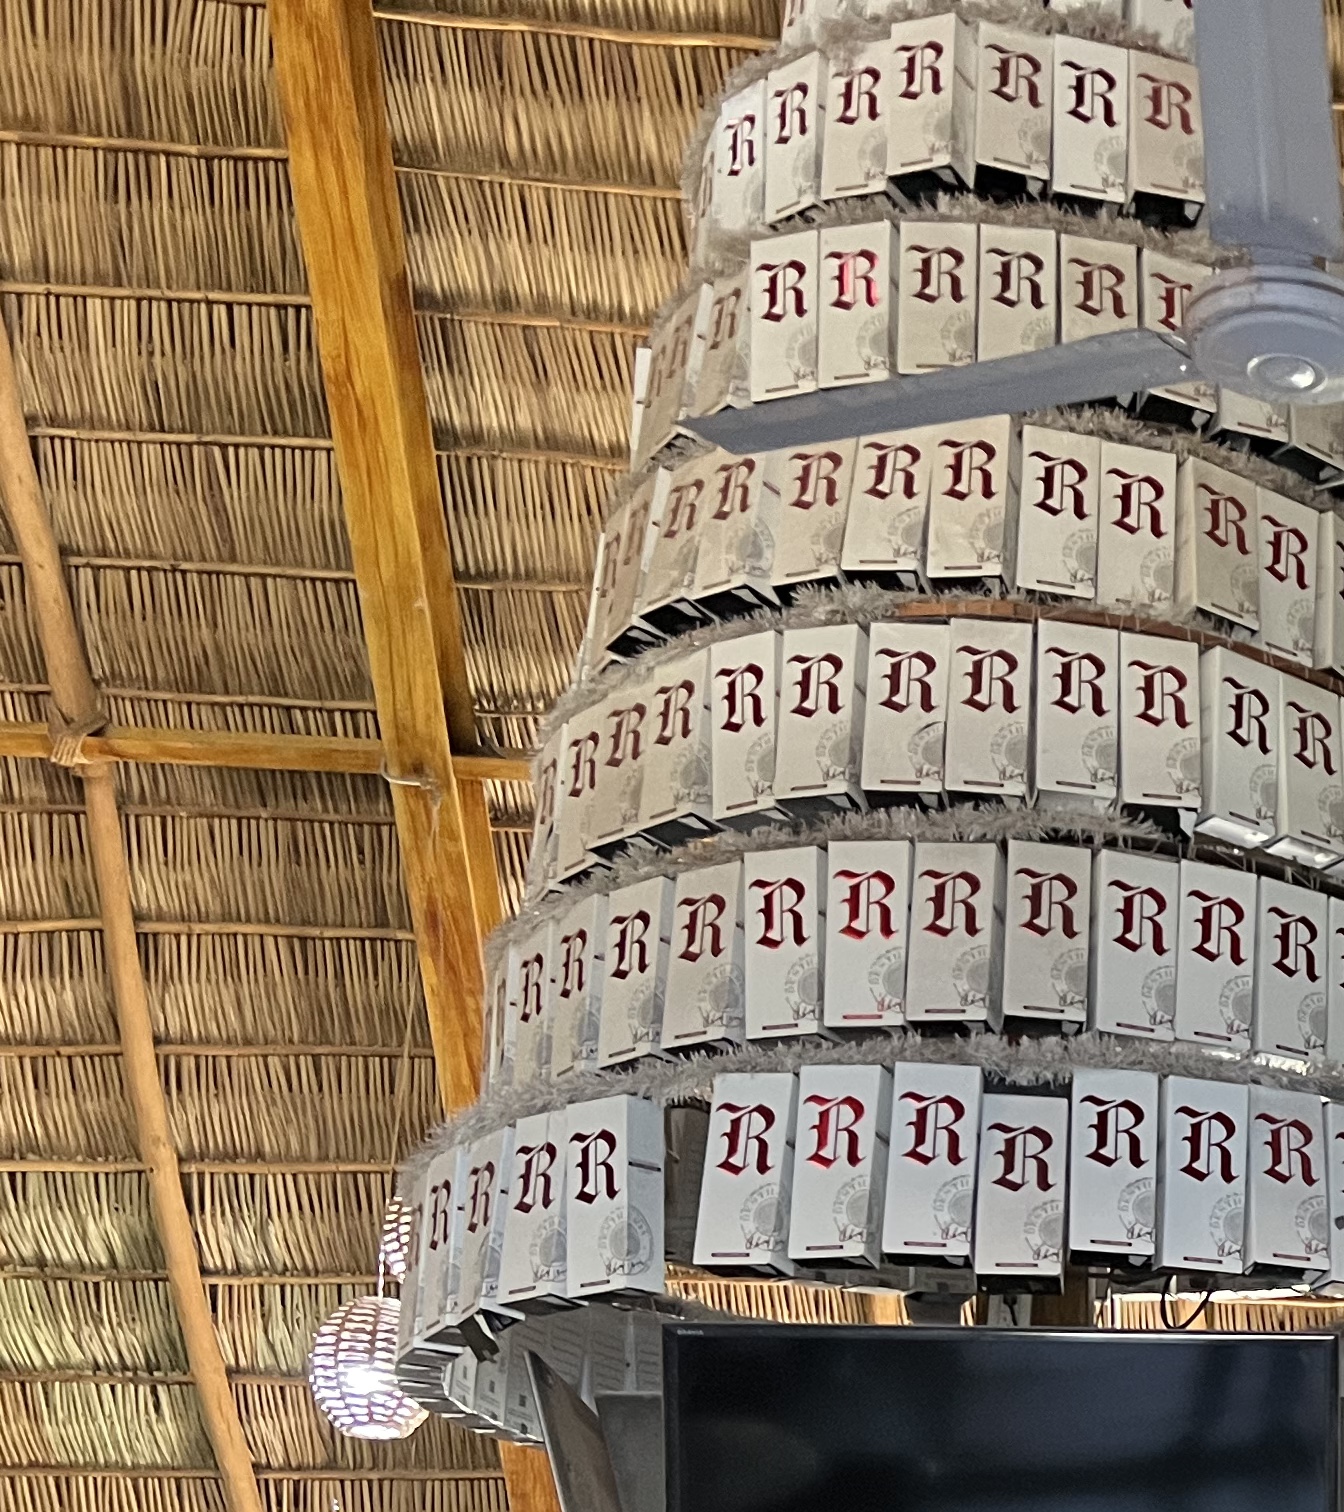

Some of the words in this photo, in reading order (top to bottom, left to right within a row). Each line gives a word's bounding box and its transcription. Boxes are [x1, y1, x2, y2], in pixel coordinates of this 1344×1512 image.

[832, 66, 881, 125] R
[894, 41, 943, 99] R
[985, 43, 1044, 108] R
[1061, 60, 1117, 127] R
[1137, 72, 1194, 134] R
[723, 113, 756, 176] R
[774, 82, 808, 145] R
[756, 259, 806, 322] R
[825, 249, 880, 310] R
[906, 244, 965, 305] R
[986, 248, 1048, 310] R
[1075, 257, 1130, 319] R
[709, 287, 741, 350] R
[712, 458, 755, 520] R
[790, 451, 842, 510] R
[861, 443, 921, 499] R
[937, 439, 998, 500] R
[1030, 450, 1088, 519] R
[1107, 467, 1166, 539] R
[664, 479, 704, 538] R
[1199, 483, 1250, 555] R
[1262, 514, 1310, 590] R
[655, 679, 695, 745] R
[715, 662, 766, 732] R
[789, 652, 844, 720] R
[877, 647, 939, 715] R
[958, 646, 1021, 715] R
[1046, 646, 1109, 718] R
[1128, 659, 1190, 731] R
[1225, 676, 1271, 755] R
[569, 731, 599, 797] R
[605, 703, 647, 767] R
[1286, 701, 1337, 775] R
[679, 892, 726, 966] R
[749, 876, 808, 953] R
[832, 867, 898, 942] R
[918, 869, 983, 940] R
[1013, 867, 1078, 940] R
[1110, 878, 1169, 956] R
[1186, 889, 1246, 966] R
[560, 928, 587, 998] R
[610, 909, 650, 979] R
[1266, 904, 1320, 982] R
[521, 952, 543, 1023] R
[716, 1101, 776, 1178] R
[803, 1092, 868, 1171] R
[900, 1090, 966, 1167] R
[988, 1122, 1054, 1193] R
[1079, 1095, 1149, 1168] R
[1174, 1105, 1240, 1185] R
[1254, 1113, 1320, 1187] R
[467, 1160, 494, 1233] R
[514, 1141, 557, 1214] R
[569, 1128, 621, 1204] R
[429, 1179, 451, 1250] R
